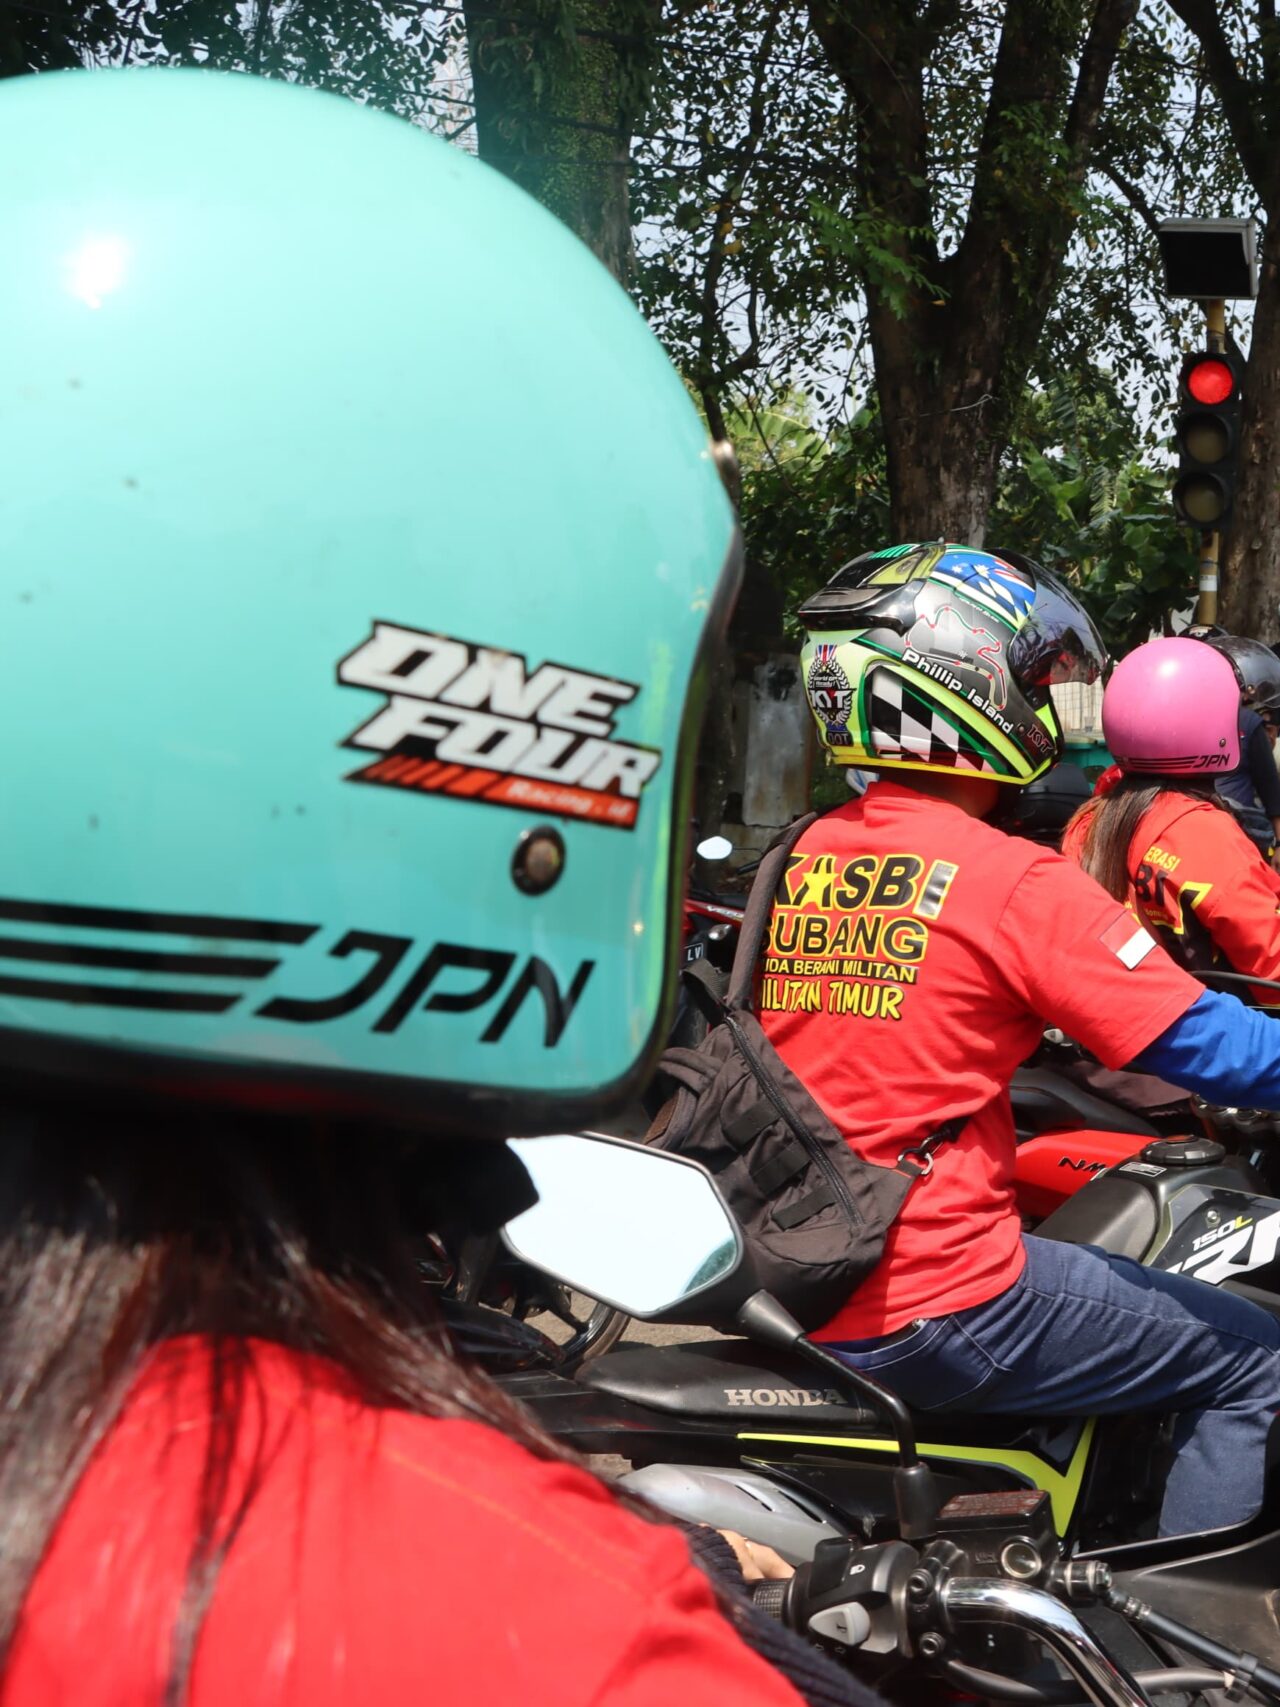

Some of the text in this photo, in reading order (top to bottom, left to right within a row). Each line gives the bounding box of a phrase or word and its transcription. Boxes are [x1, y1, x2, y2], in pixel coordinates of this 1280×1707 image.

[337, 619, 641, 741] ONE
[901, 649, 1014, 735] Phillip Island
[341, 694, 662, 800] FOUR
[1192, 753, 1231, 768] JPN
[506, 781, 593, 814] Racing
[775, 854, 959, 920] KASBI
[252, 929, 596, 1048] JPN
[793, 960, 839, 975] BERANI
[842, 959, 915, 983] MILITAN
[829, 980, 904, 1020] TIMUR
[1192, 1216, 1253, 1251] 150L
[724, 1388, 849, 1406] HONDA
